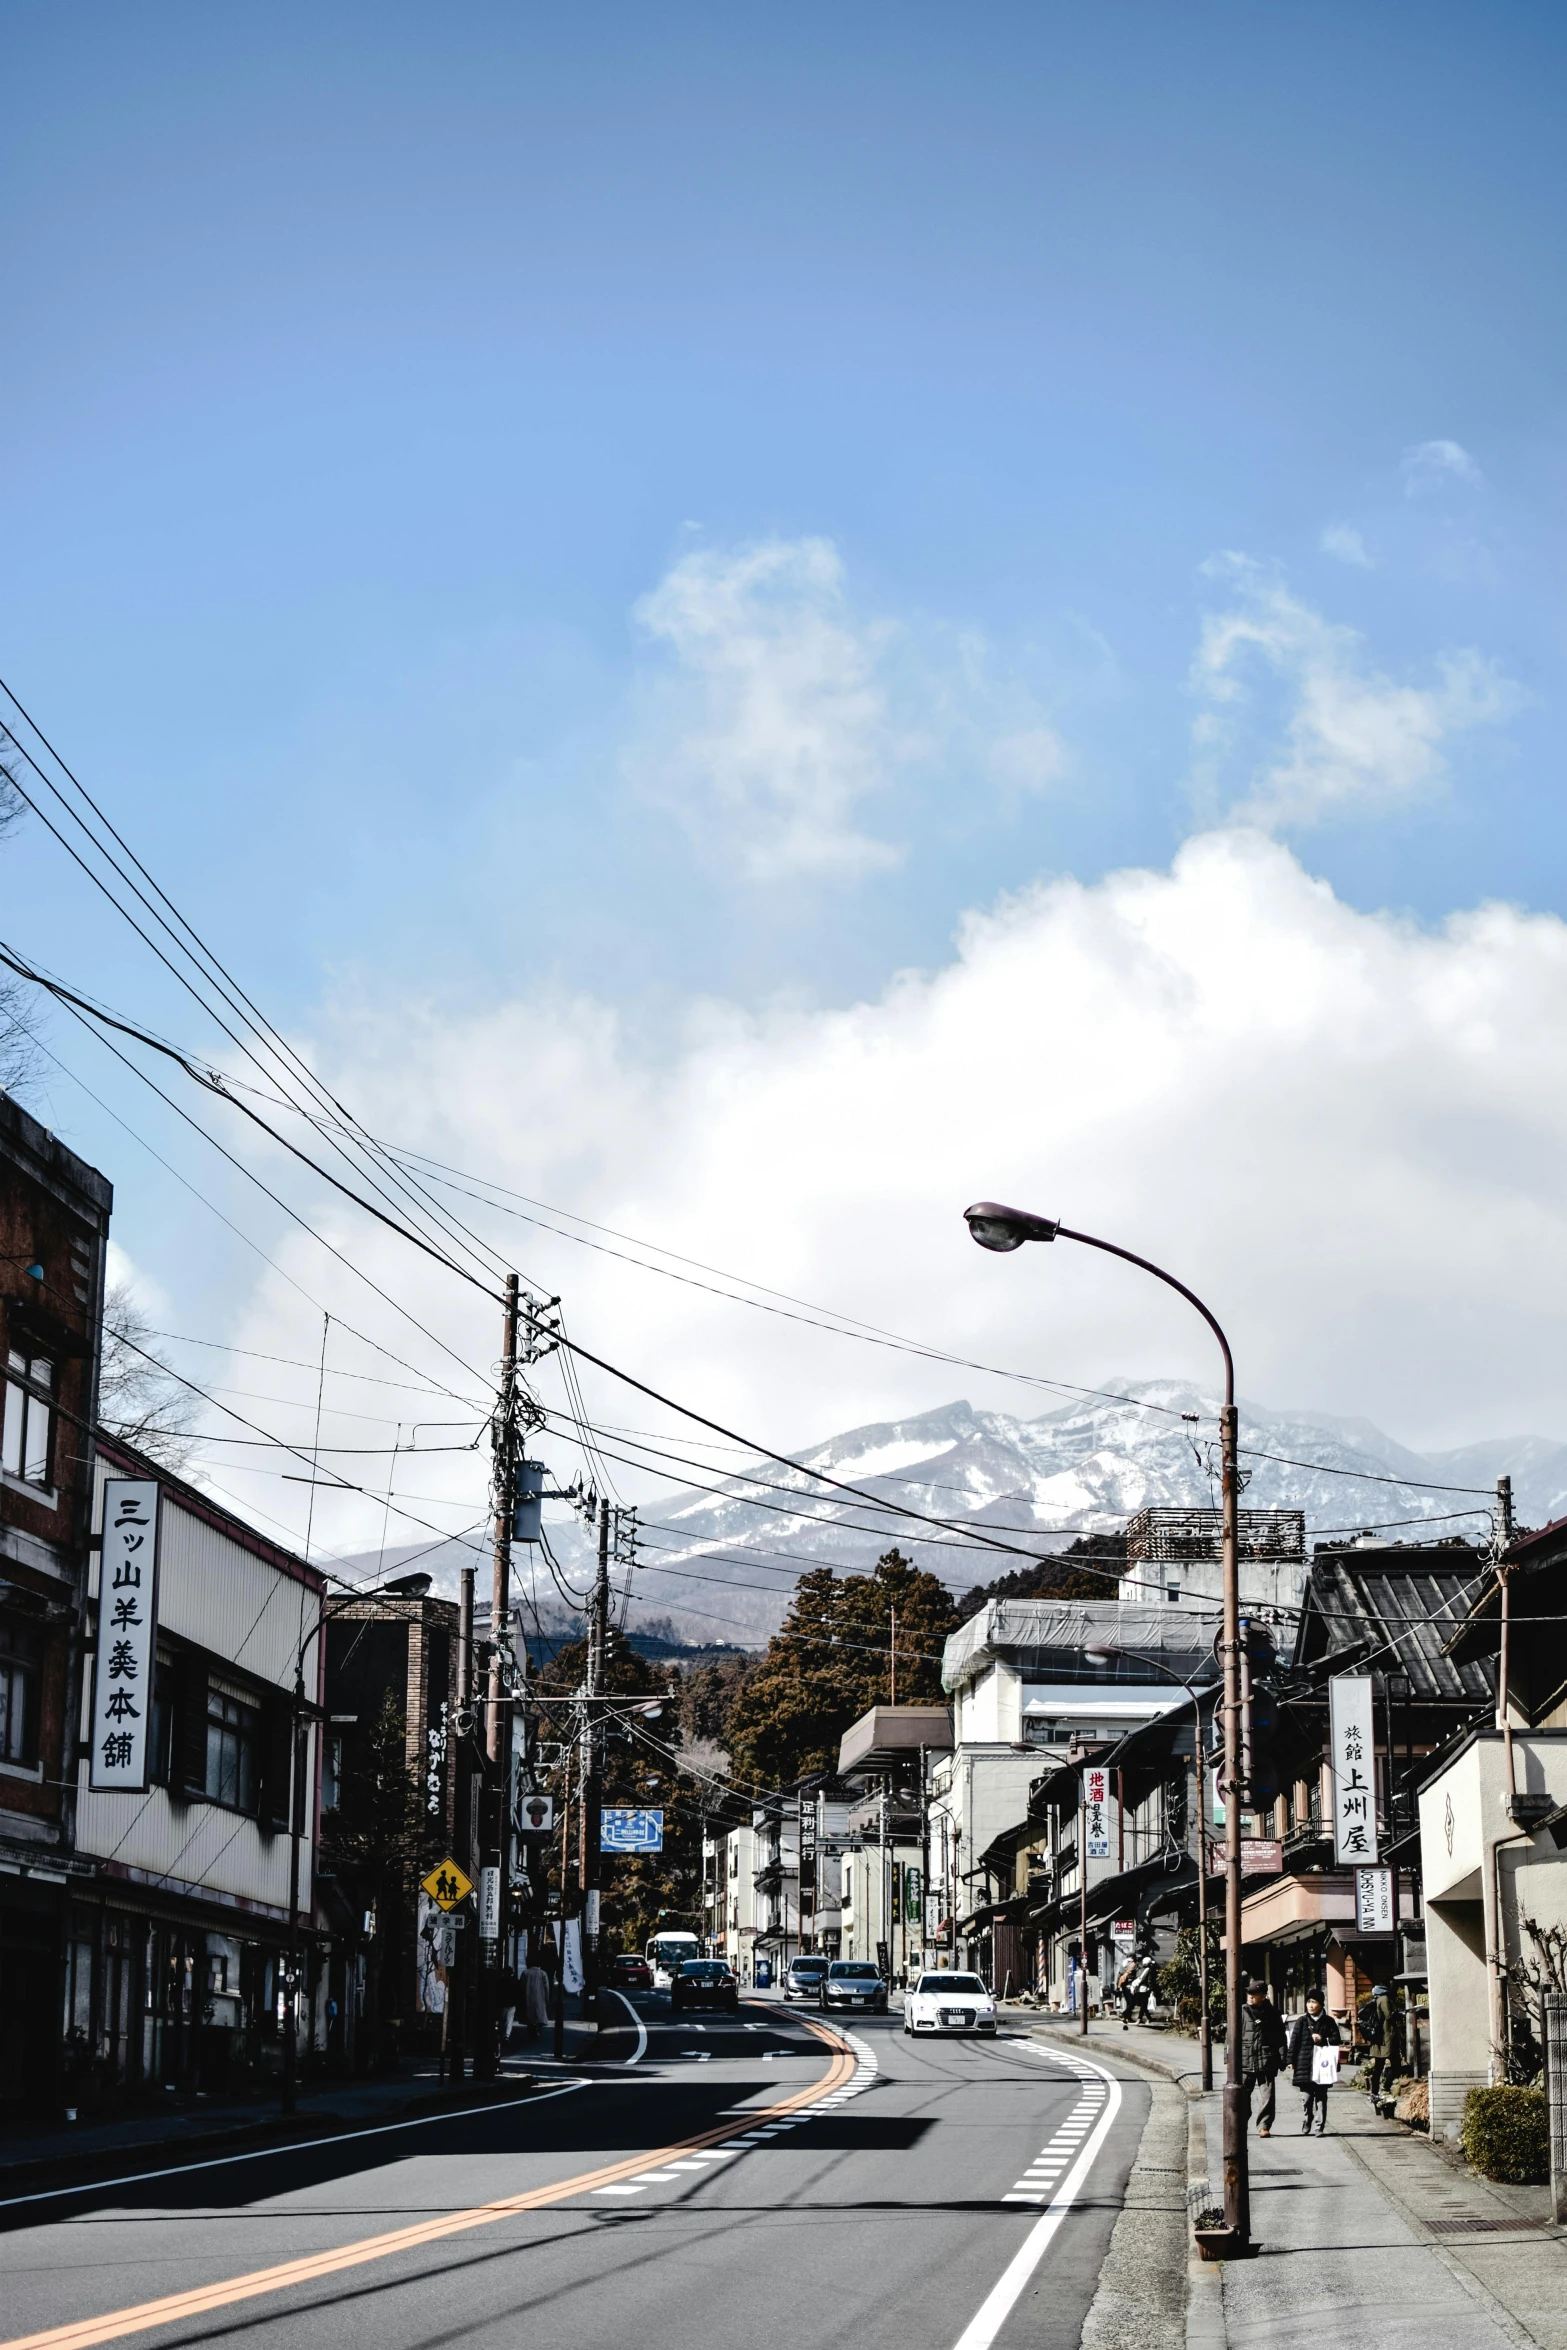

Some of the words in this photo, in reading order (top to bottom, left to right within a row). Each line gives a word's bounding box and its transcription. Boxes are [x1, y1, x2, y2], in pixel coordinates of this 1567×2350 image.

[1344, 1725, 1364, 1761] 旅館
[1089, 1771, 1105, 1803] 地酒
[1341, 1768, 1370, 1854] 上州屋
[1090, 1848, 1106, 1856] 酒店
[1360, 1869, 1375, 1914] JOHSYU-YA
[1380, 1870, 1388, 1893] NIKKO
[1381, 1894, 1389, 1919] ONSEN
[429, 1916, 463, 1927] 通学路
[1362, 1916, 1376, 1930] INN
